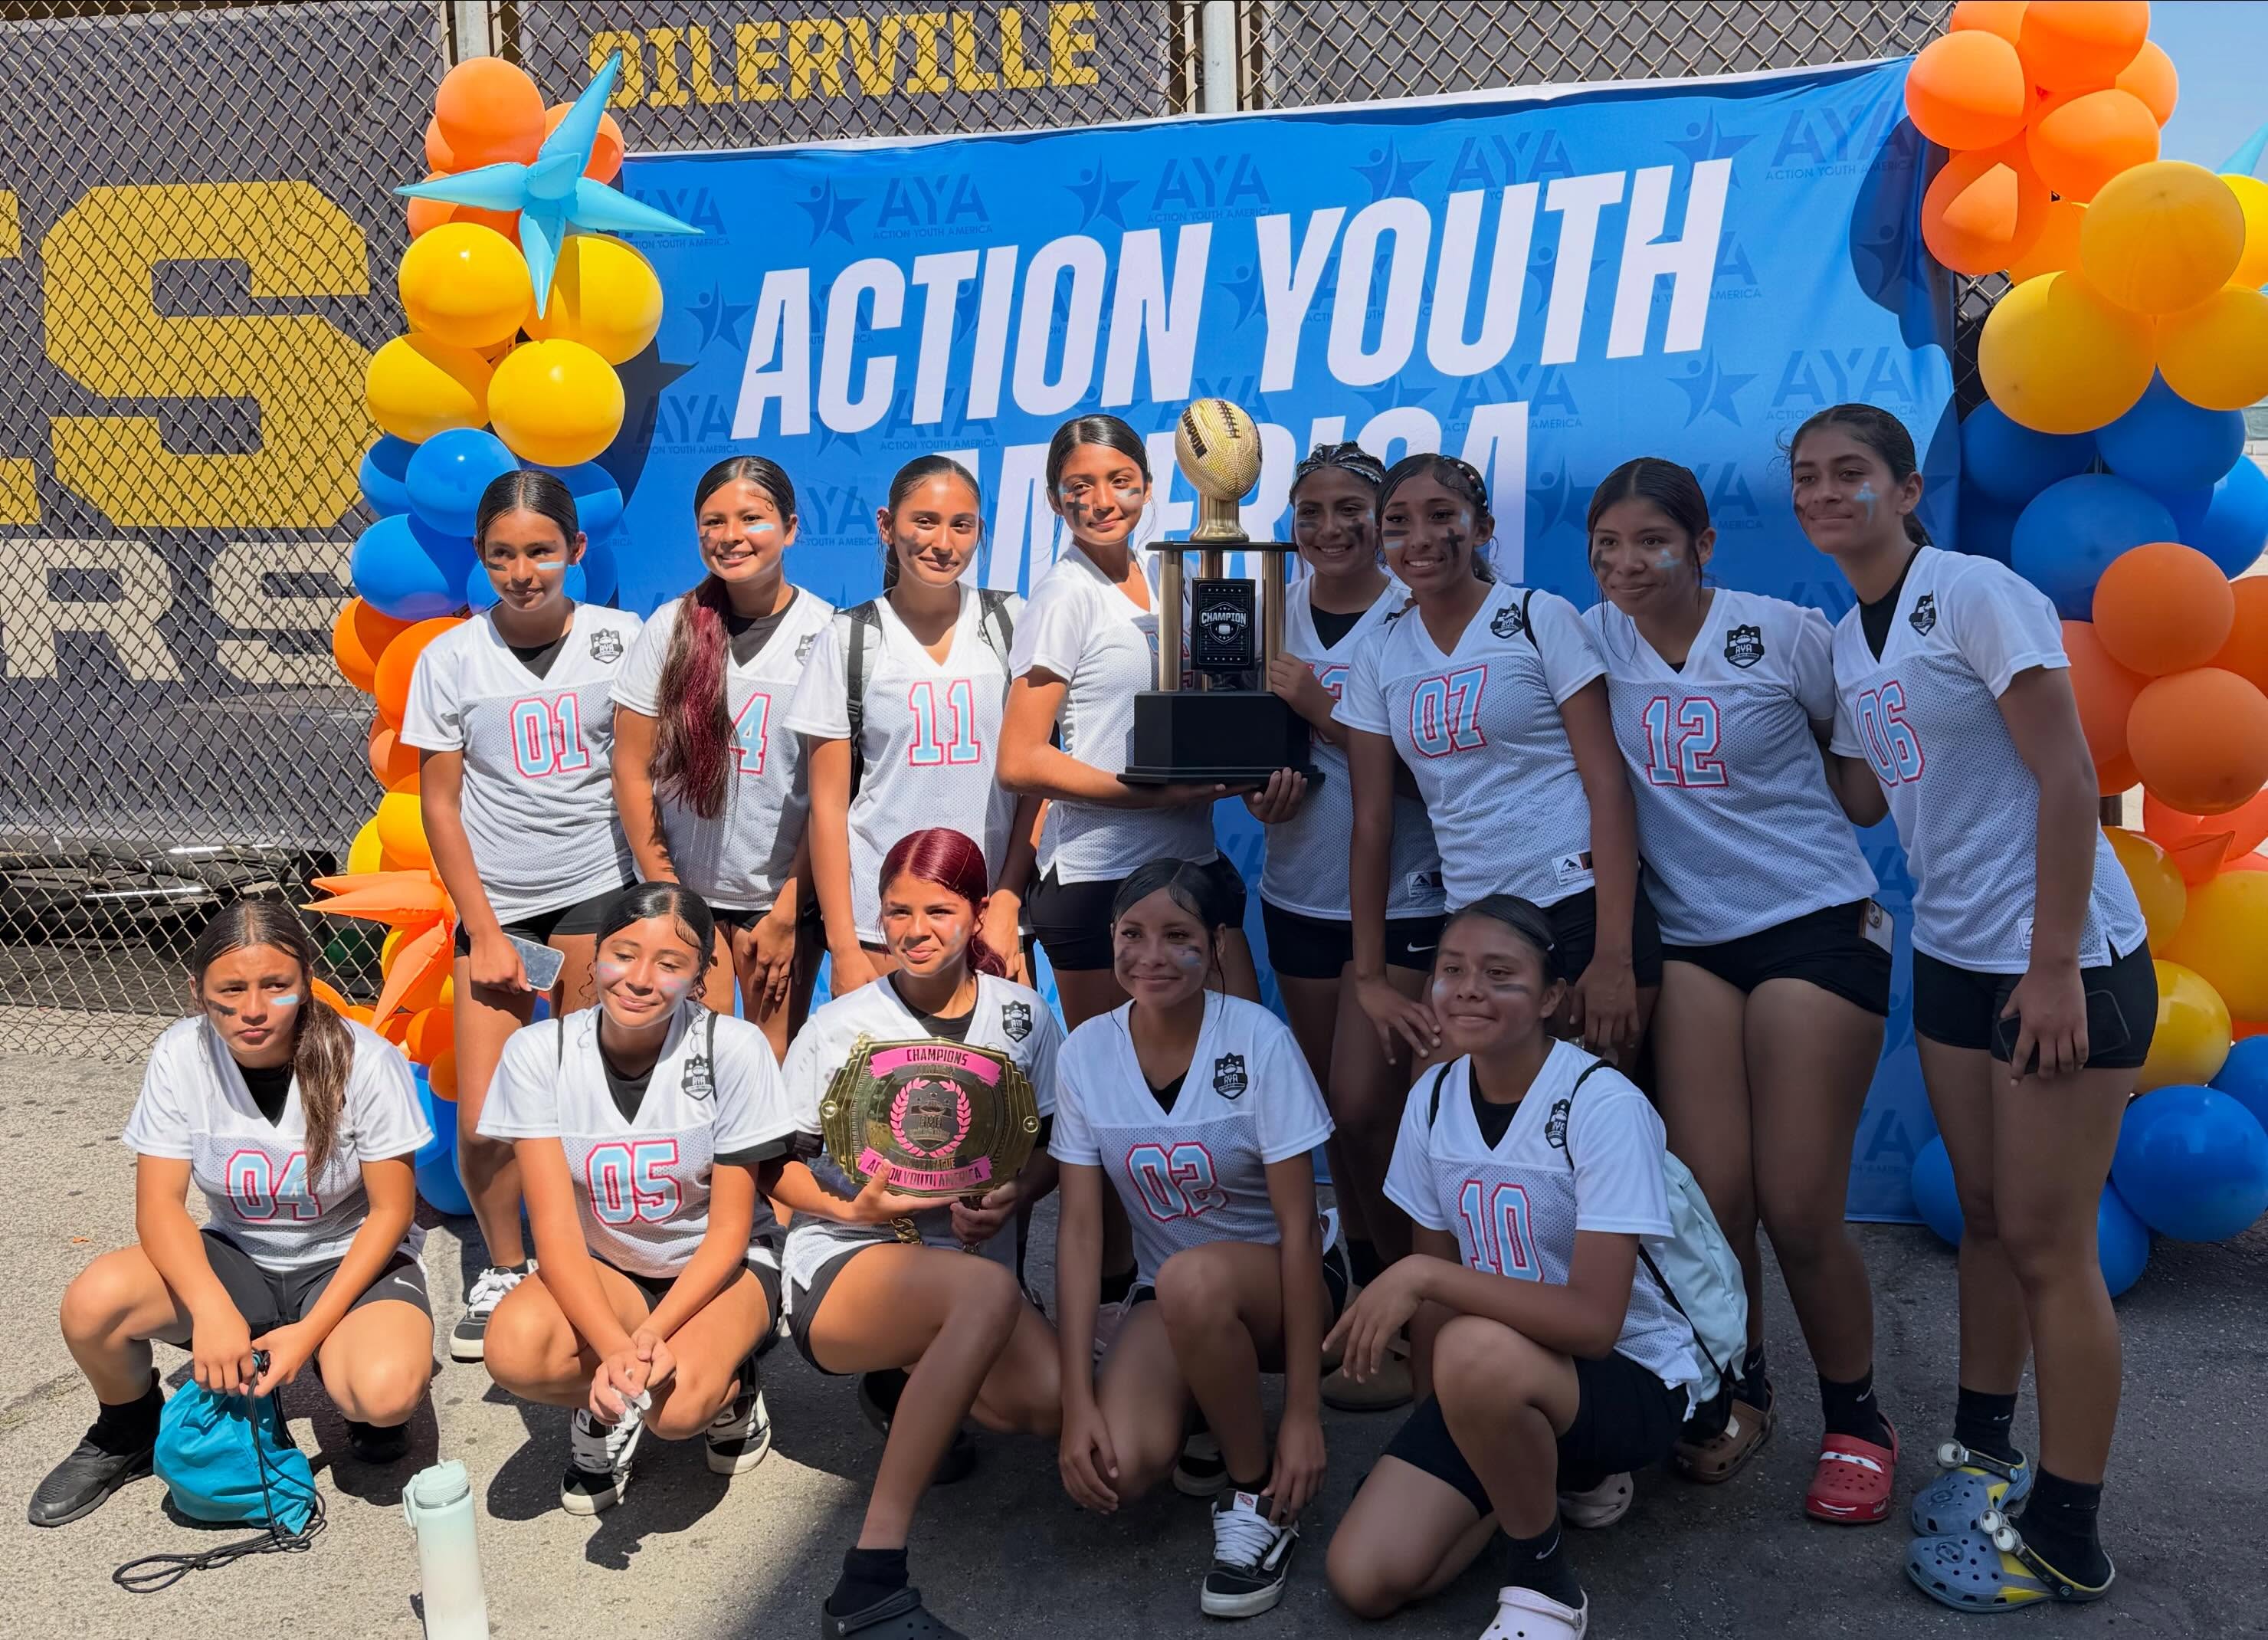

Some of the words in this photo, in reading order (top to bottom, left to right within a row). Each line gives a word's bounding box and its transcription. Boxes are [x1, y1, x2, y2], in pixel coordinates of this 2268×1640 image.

[588, 2, 1099, 110] OILERVILLE
[1446, 129, 1575, 192] AYA
[1771, 101, 1913, 167] AYA
[877, 173, 990, 228] AYA
[1152, 153, 1272, 211] AYA
[1765, 168, 1814, 181] ACTION
[1817, 164, 1856, 177] YOUTH
[873, 230, 910, 240] ACTION
[914, 228, 945, 238] YOUTH
[949, 225, 993, 236] AMERICA
[1146, 212, 1187, 223] ACTION
[1190, 208, 1224, 221] YOUTH
[1227, 205, 1275, 218] AMERICA
[657, 239, 687, 250] YOUTH
[689, 237, 730, 247] AMERICA
[731, 222, 1213, 440] ACTION
[1256, 157, 1733, 393] YOUTH
[0, 180, 385, 528] S
[1771, 346, 1913, 407] AYA
[636, 394, 732, 444] AYA
[1448, 363, 1578, 419] AYA
[669, 445, 696, 454] YOUTH
[699, 444, 739, 454] AMERICA
[880, 441, 917, 451] ACTION
[920, 440, 951, 450] YOUTH
[953, 438, 999, 448] AMERICA
[1530, 418, 1583, 430] AMERICA
[1717, 519, 1764, 530] MERICA
[1201, 612, 1247, 626] CHAMPION
[1735, 644, 1752, 655] AYA
[510, 692, 591, 779] 01
[909, 679, 981, 767] 11
[1410, 664, 1487, 759] 07
[1857, 681, 1926, 788] 06
[1643, 695, 1729, 789] 12
[906, 1048, 968, 1067] CHAMPIONS
[226, 1150, 322, 1221] 04
[585, 1138, 683, 1228] 05
[866, 1159, 902, 1182] ACON
[903, 1171, 936, 1187] YOUTH
[1126, 1141, 1227, 1223] 02
[1459, 1179, 1544, 1284] 10
